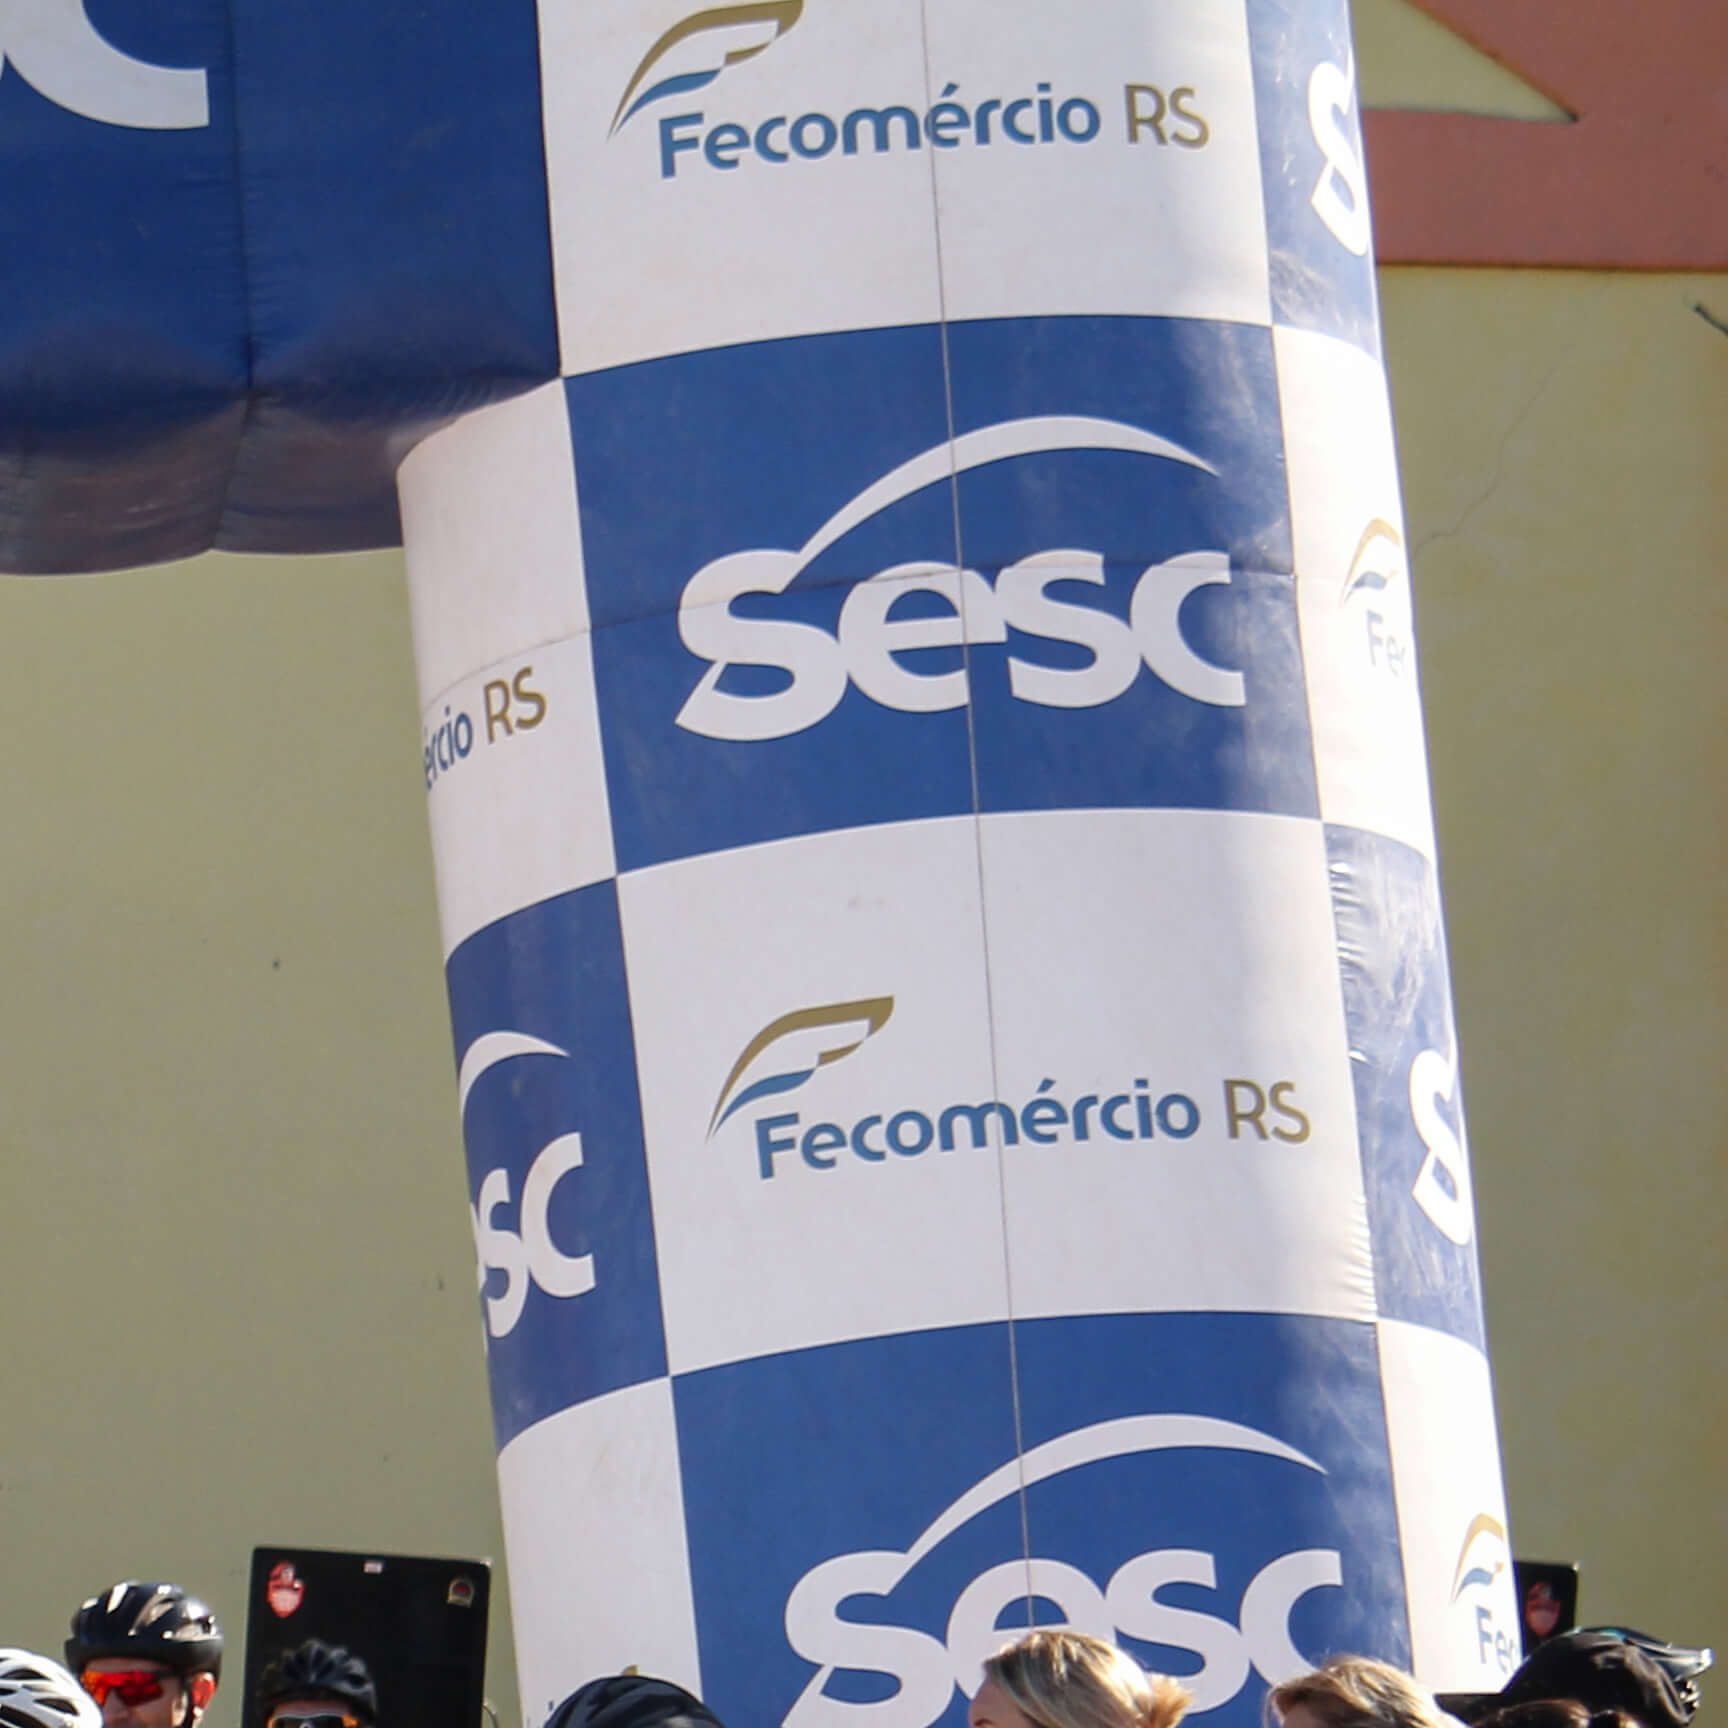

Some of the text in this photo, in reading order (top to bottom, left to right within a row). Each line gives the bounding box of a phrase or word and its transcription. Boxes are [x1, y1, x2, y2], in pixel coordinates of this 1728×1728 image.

[658, 82, 1212, 178] Fecomércio RS
[483, 665, 547, 744] RS
[754, 1078, 1313, 1181] Fecomércio RS
